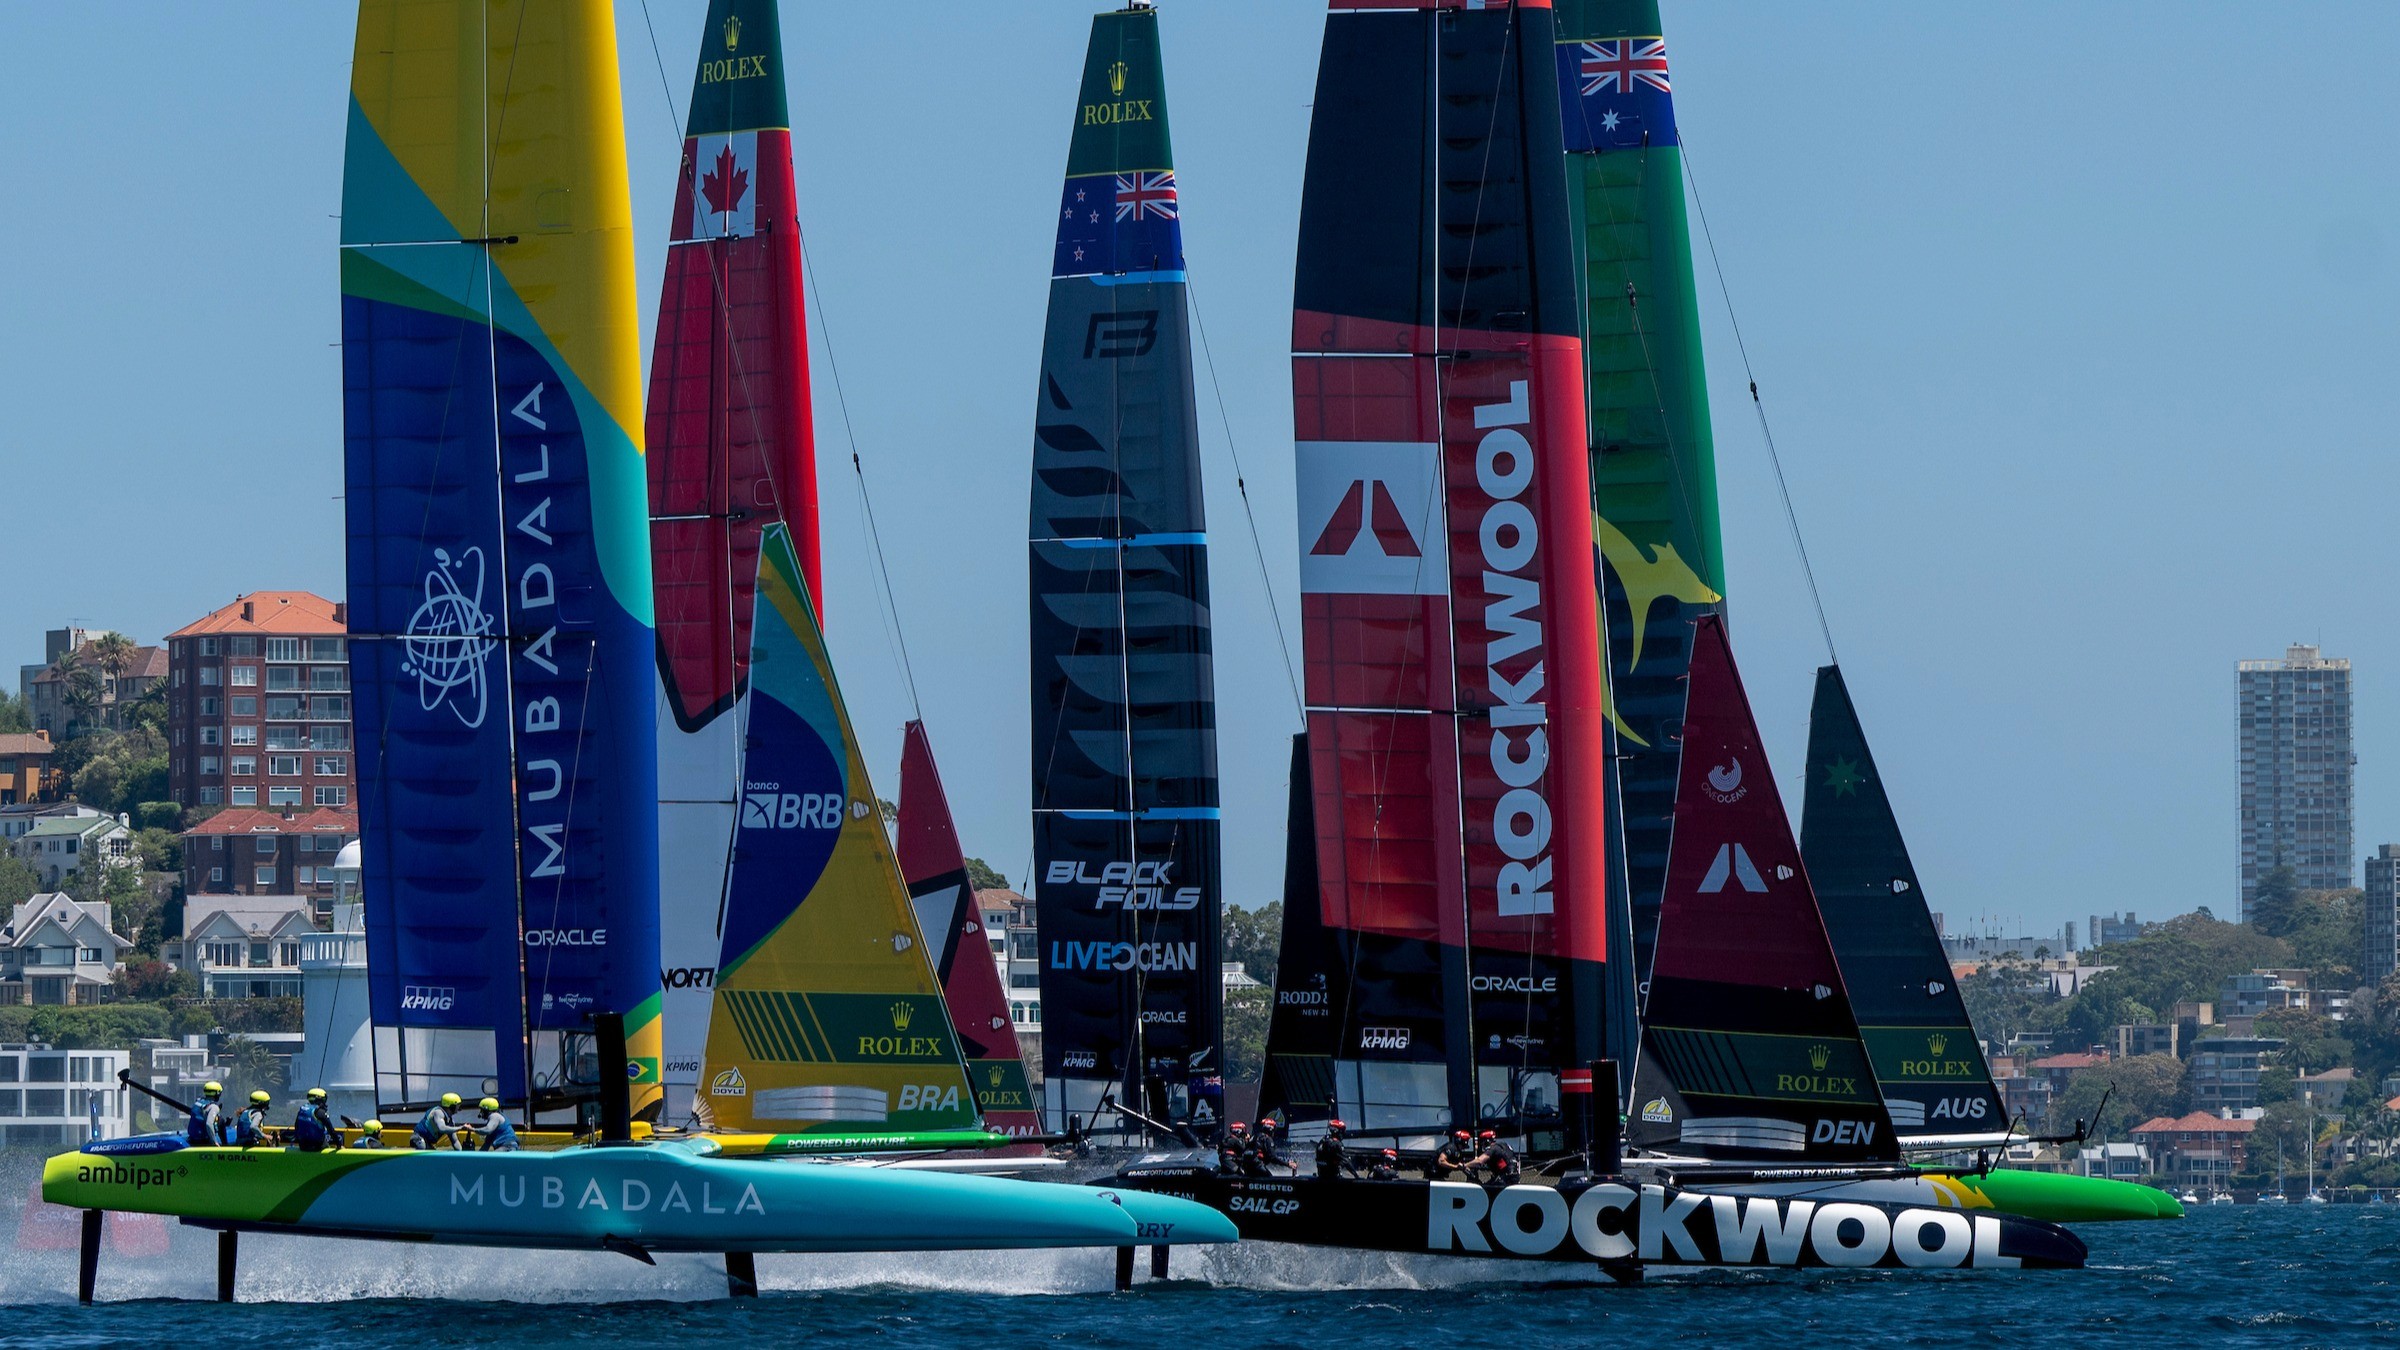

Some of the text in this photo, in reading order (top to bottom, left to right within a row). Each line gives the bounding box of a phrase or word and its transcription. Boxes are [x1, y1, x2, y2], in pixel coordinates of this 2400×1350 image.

[702, 55, 767, 84] ROLEX
[1083, 100, 1153, 126] ROLEX
[511, 382, 566, 878] MUBADALA
[1473, 380, 1554, 916] ROCKWOOL
[746, 780, 780, 790] banco
[778, 794, 843, 829] BRB
[1045, 861, 1175, 885] BLACK
[1095, 887, 1201, 910] FOILS
[525, 929, 607, 946] ORACLE
[661, 967, 715, 993] NORT
[1471, 976, 1557, 992] ORACLE
[401, 994, 454, 1010] KPMG
[1279, 991, 1321, 1005] RODD
[1141, 1011, 1187, 1023] ORACLE
[858, 1036, 942, 1057] ROLEX
[1361, 1035, 1409, 1049] KPMG
[665, 1061, 699, 1072] KPMG
[1063, 1057, 1096, 1068] KPMG
[1900, 1060, 1972, 1076] ROLEX
[1777, 1074, 1856, 1095] ROLEX
[897, 1085, 960, 1112] BRA
[978, 1090, 1022, 1105] OLEX
[1643, 1114, 1671, 1122] DOYLE
[1931, 1098, 1988, 1119] AUS
[1812, 1119, 1875, 1145] DEN
[787, 1138, 843, 1149] POWERED
[844, 1138, 860, 1148] BY
[78, 1162, 175, 1190] ambipar
[1753, 1169, 1802, 1179] POWERED
[1803, 1169, 1817, 1178] BY
[451, 1173, 765, 1216] MUBADALA
[1249, 1183, 1293, 1192] SEHESTED
[1427, 1181, 2022, 1269] ROCKWOOL
